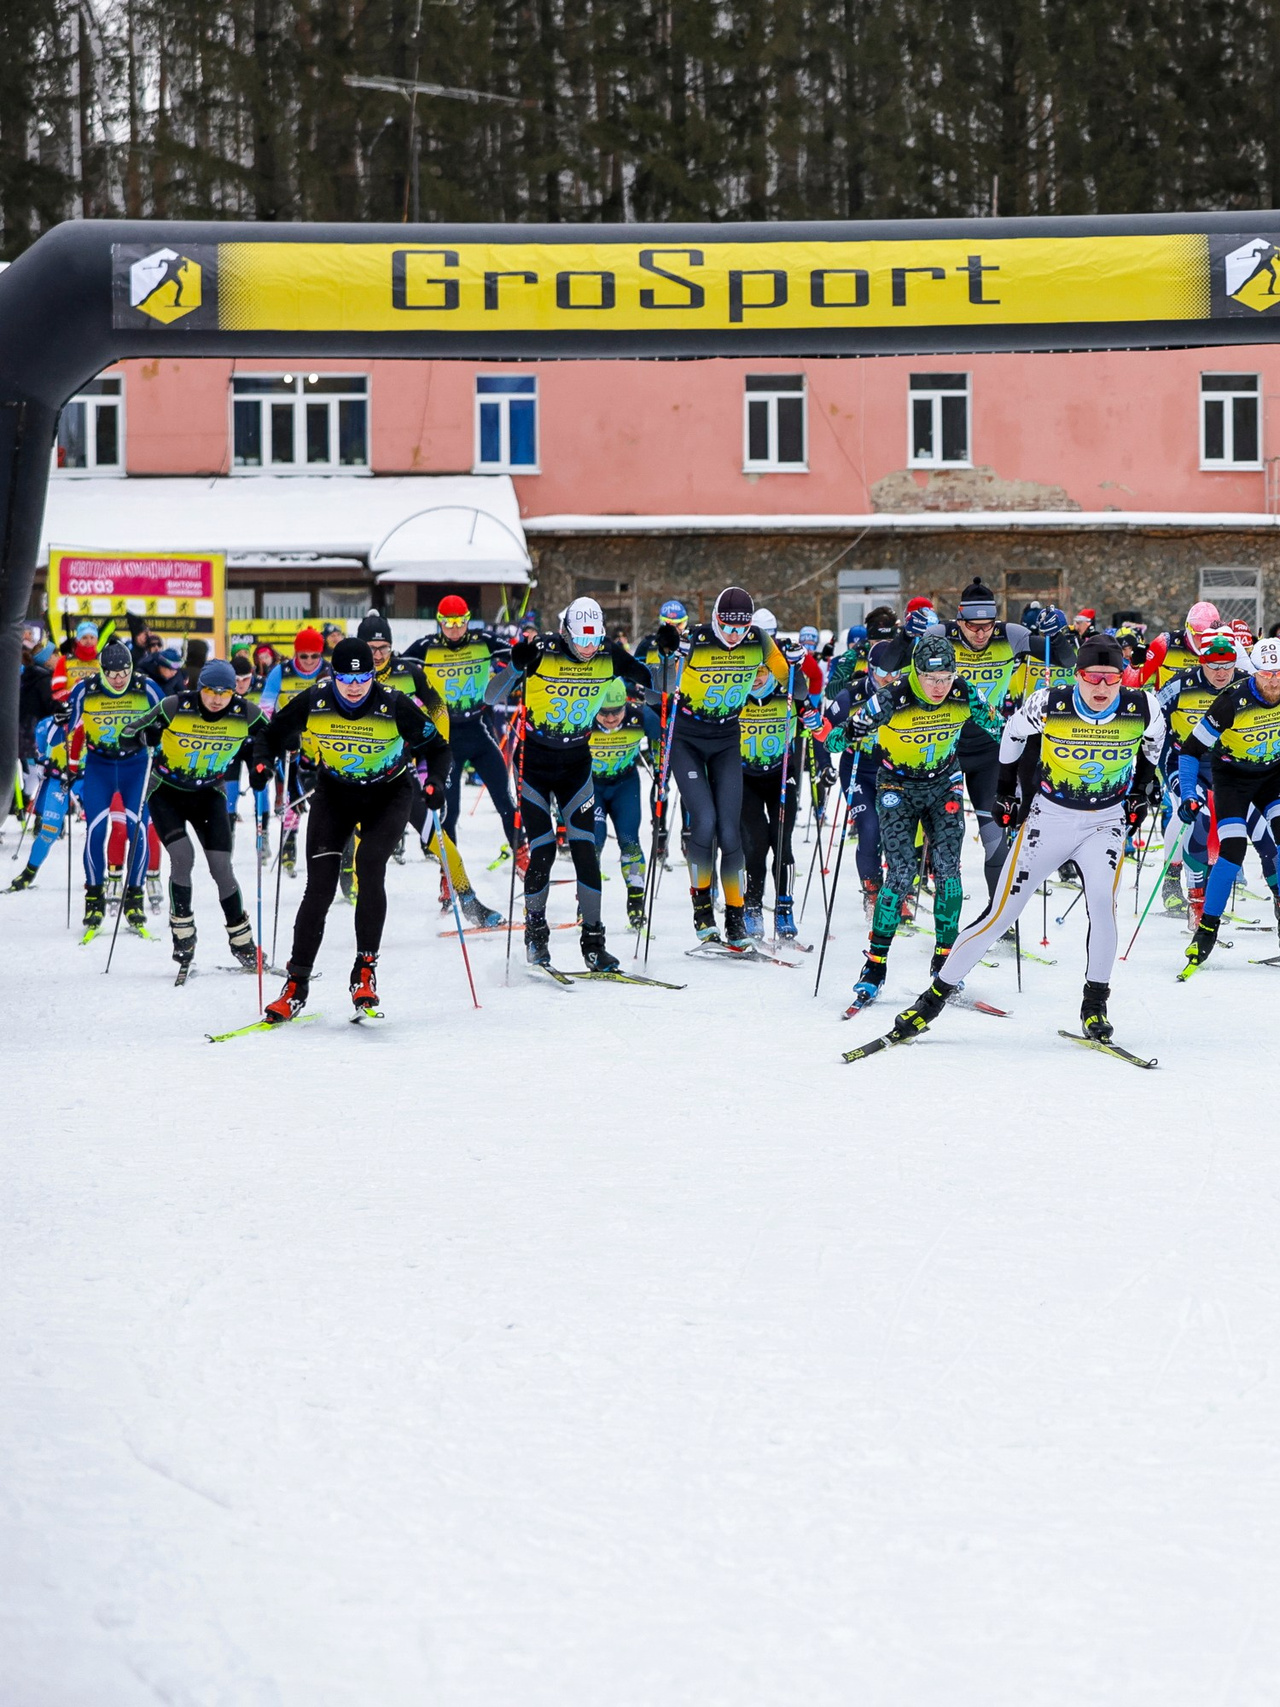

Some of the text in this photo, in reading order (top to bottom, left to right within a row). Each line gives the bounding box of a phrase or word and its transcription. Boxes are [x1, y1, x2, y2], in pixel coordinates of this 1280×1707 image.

[392, 249, 1001, 322] GroSport
[69, 560, 202, 579] НОВОГОДНИЙ КОМАНДНЫЙ СПРИНТ
[1261, 643, 1277, 653] 20
[437, 664, 482, 678] согаз
[700, 672, 753, 684] согаз
[957, 669, 1003, 680] огаз
[444, 675, 479, 702] 54
[545, 684, 600, 697] согаз
[703, 684, 744, 709] 56
[545, 697, 590, 725] 38
[911, 713, 951, 722] ВИКТОРИЯ
[330, 723, 374, 732] ВИКТОРИЯ
[1072, 727, 1120, 735] ВИКТОРИЯ
[178, 738, 233, 751] согаз
[318, 740, 386, 754] согаз
[744, 735, 780, 757] 19
[919, 744, 936, 763] 1
[1053, 746, 1133, 760] согаз
[184, 751, 221, 770] 11
[340, 753, 366, 773] 2
[1079, 761, 1106, 784] 3
